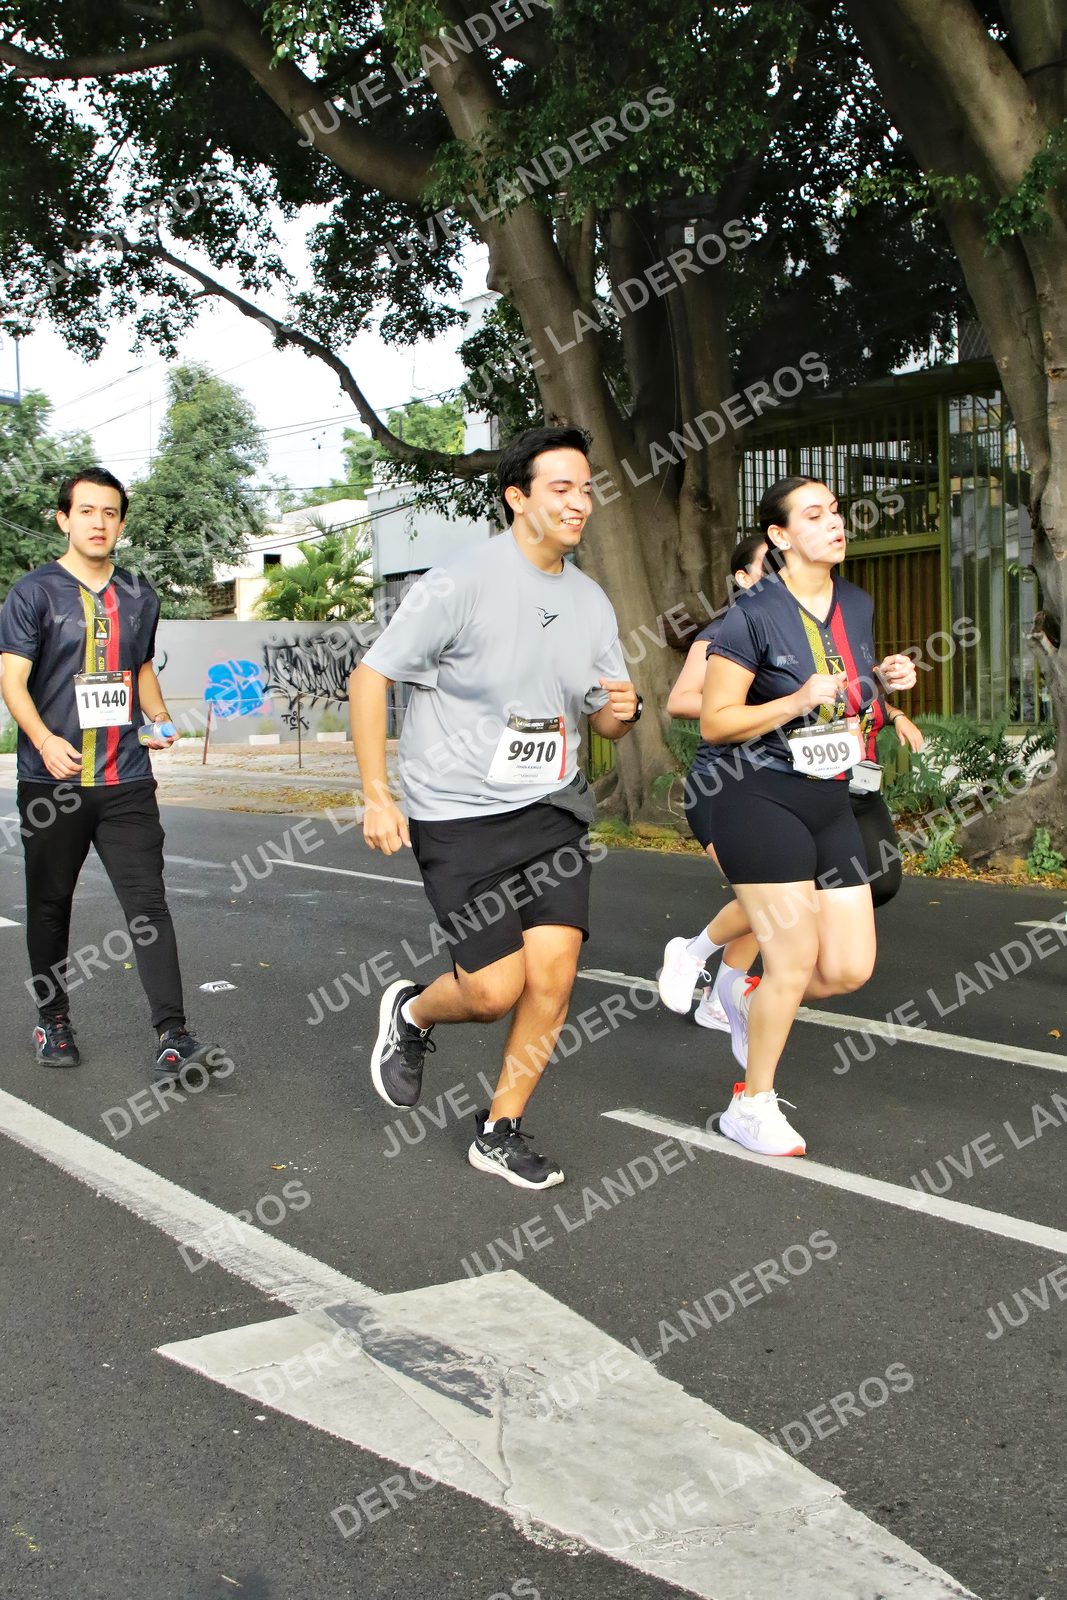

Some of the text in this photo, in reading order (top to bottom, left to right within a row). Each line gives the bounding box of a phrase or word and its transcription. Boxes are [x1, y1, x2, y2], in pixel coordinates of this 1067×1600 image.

[81, 689, 127, 709] 11440
[508, 740, 556, 763] 9910
[802, 741, 850, 766] 9909
